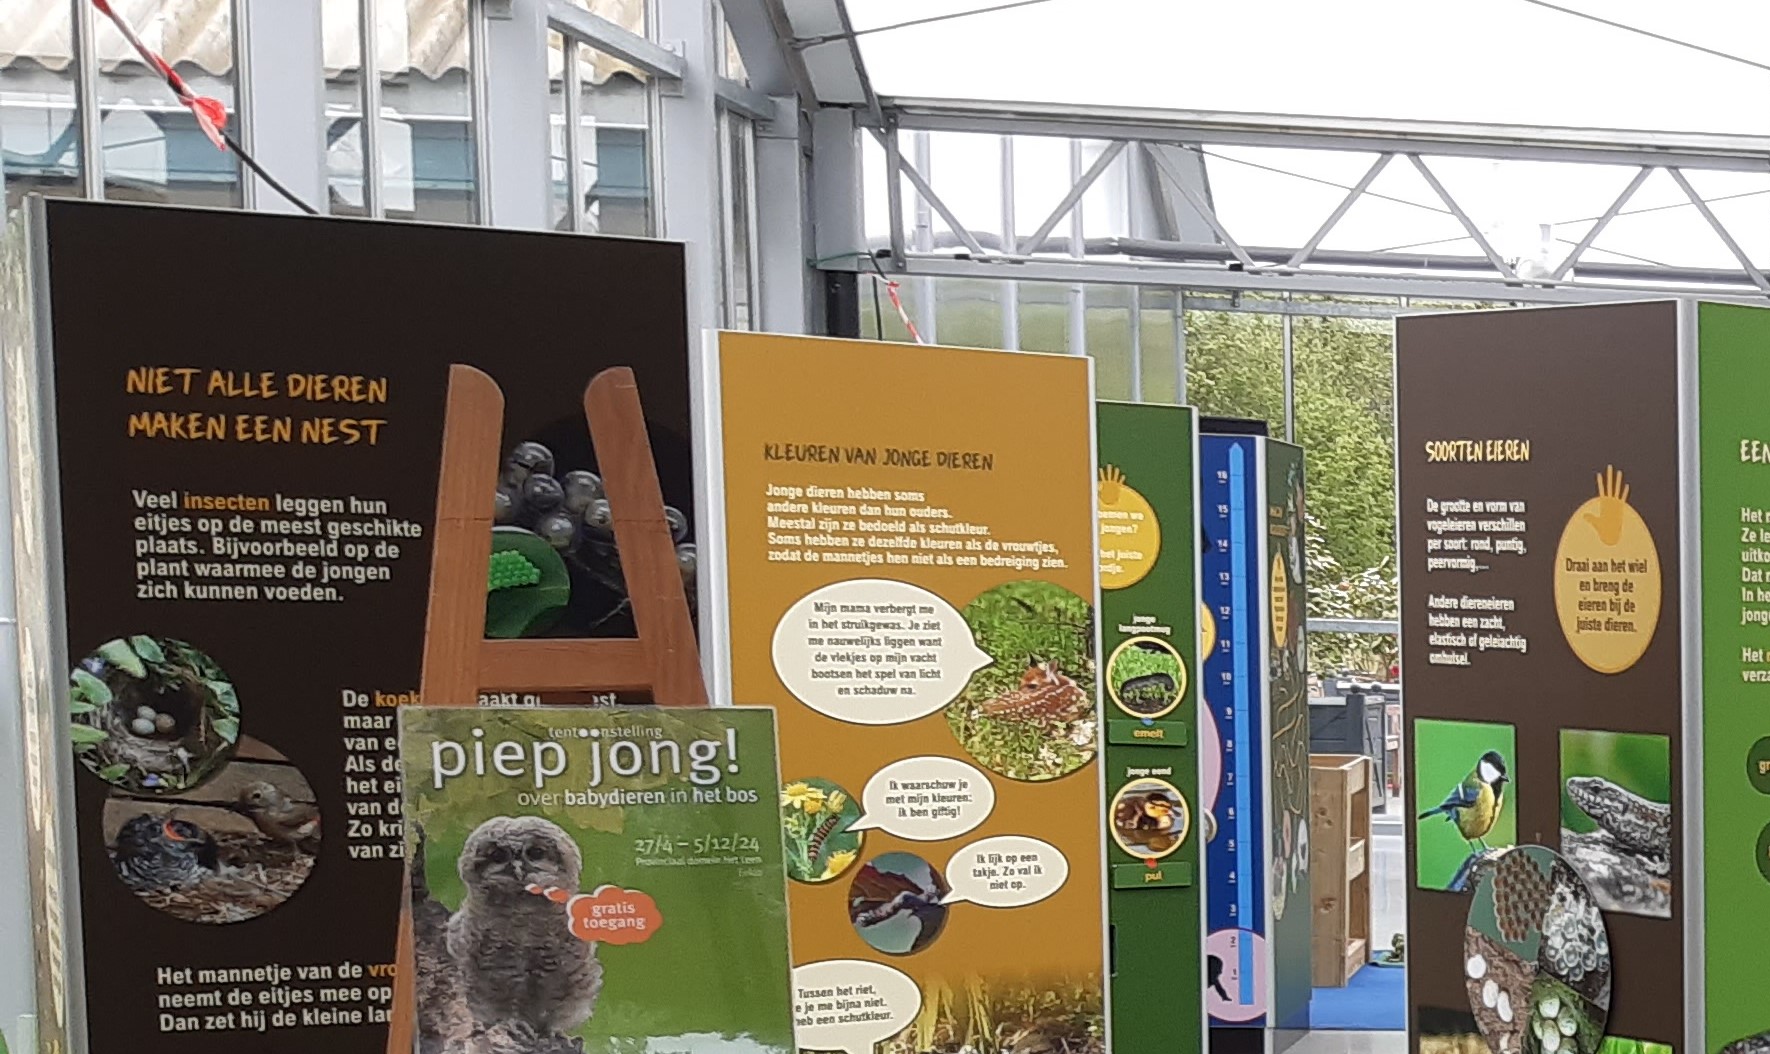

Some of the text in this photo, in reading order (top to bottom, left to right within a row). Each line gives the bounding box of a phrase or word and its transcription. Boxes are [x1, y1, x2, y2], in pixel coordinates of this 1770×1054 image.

[126, 367, 386, 402] NIET ALLE DIEREN
[129, 412, 386, 444] MAKEN EEN NEST
[764, 443, 993, 469] KLEUREN VAN JONGE DIEREN
[1425, 439, 1529, 461] SOORTEN EIEREN
[765, 483, 924, 501] Jonge dieren hebben soms
[132, 489, 386, 516] Veel insecten leggen hun
[1217, 504, 1231, 514] 15
[1741, 507, 1762, 522] Het
[134, 515, 421, 540] eitjes op de meest geschikte
[1741, 527, 1756, 542] Ze
[135, 537, 399, 562] plaats. Bijvoorbeeld op de
[136, 558, 390, 584] plant waarmee de jongen
[1565, 557, 1647, 573] Draai aan het wiel
[1741, 567, 1762, 582] Dat
[136, 580, 343, 600] zich kunnen voeden.
[1579, 578, 1633, 595] en breng de
[1578, 597, 1635, 615] eieren bij de
[1575, 616, 1637, 633] juiste dieren.
[1742, 647, 1763, 662] Het
[1133, 729, 1163, 738] emelt
[431, 728, 565, 787] piep
[587, 727, 738, 784] jong!
[518, 786, 757, 810] over babydieren in het bos
[1144, 870, 1161, 882] pul
[591, 901, 635, 917] gratis
[583, 912, 645, 930] toegang
[157, 961, 362, 984] Het mannetje van de
[158, 986, 394, 1007] neemt de eitjes mee op
[159, 1007, 362, 1030] Dan zet hij de kleine
